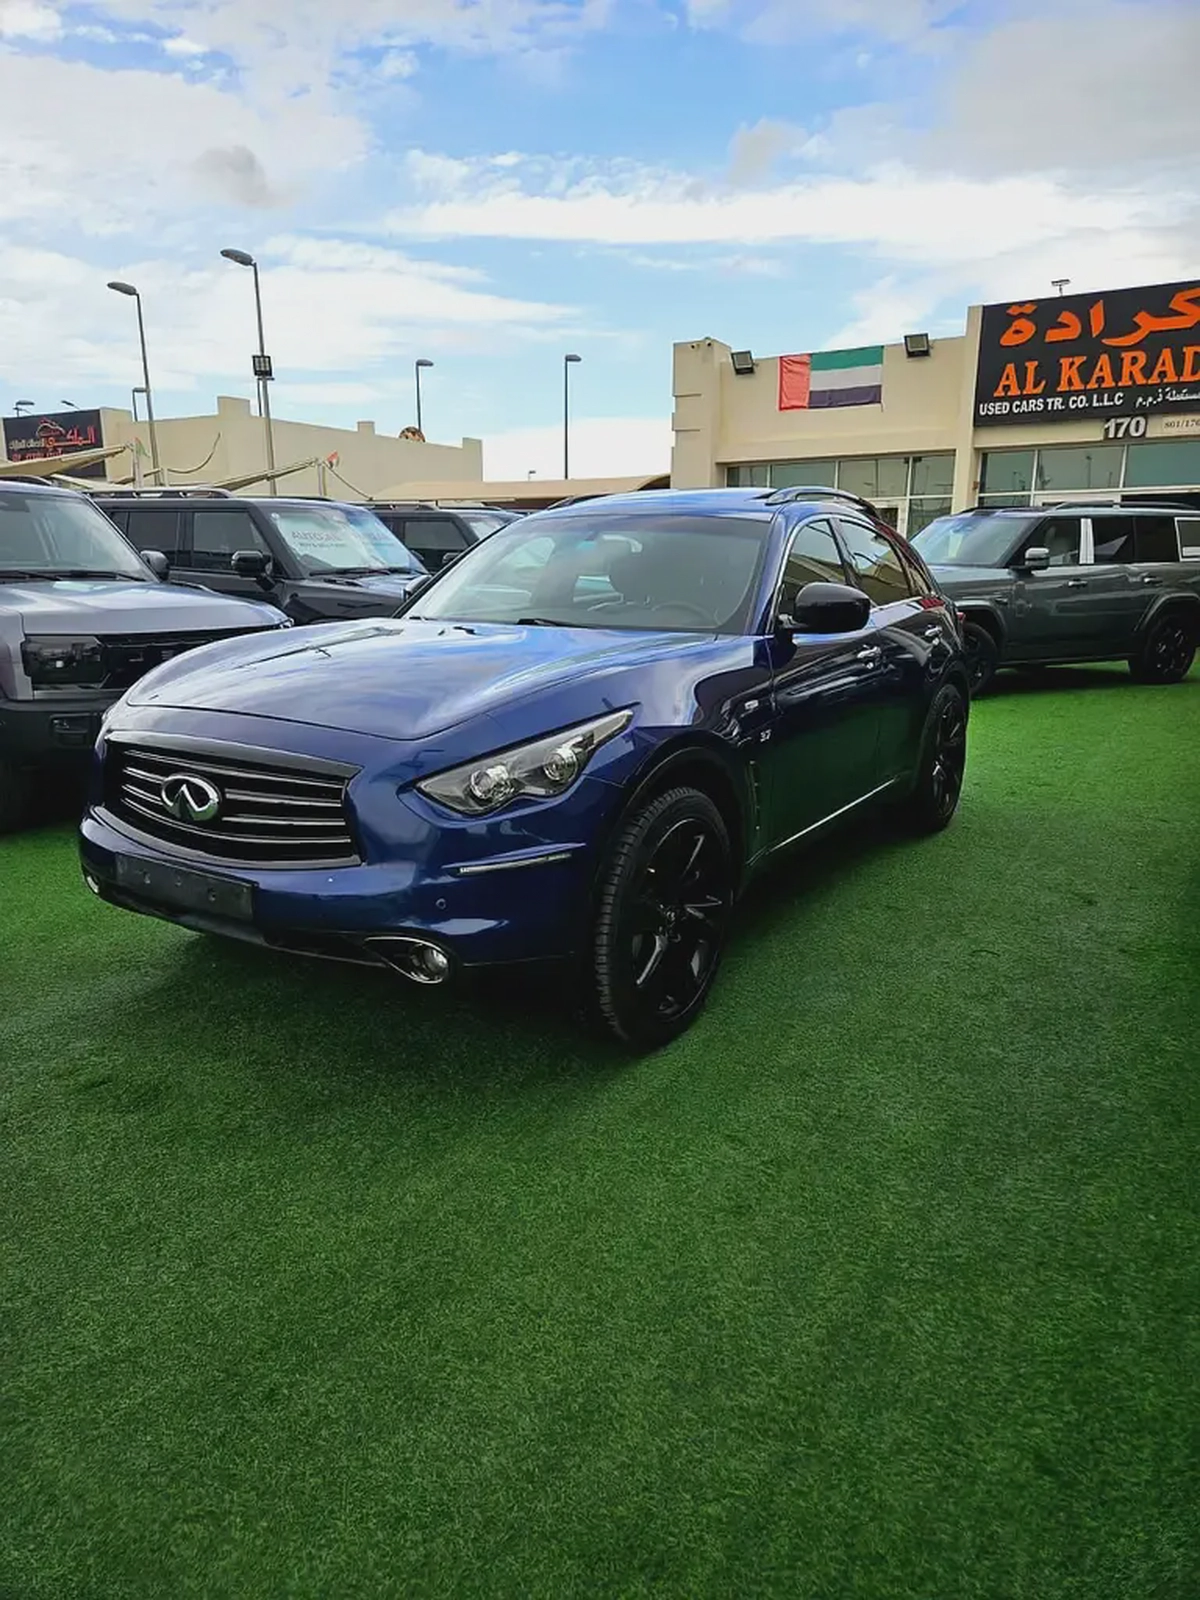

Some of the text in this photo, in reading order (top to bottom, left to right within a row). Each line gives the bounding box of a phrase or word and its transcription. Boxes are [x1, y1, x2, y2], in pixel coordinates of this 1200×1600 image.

[993, 360, 1047, 397] AL
[979, 392, 1124, 416] USED CARS TR. CO. L.L.C
[1103, 416, 1146, 439] 170
